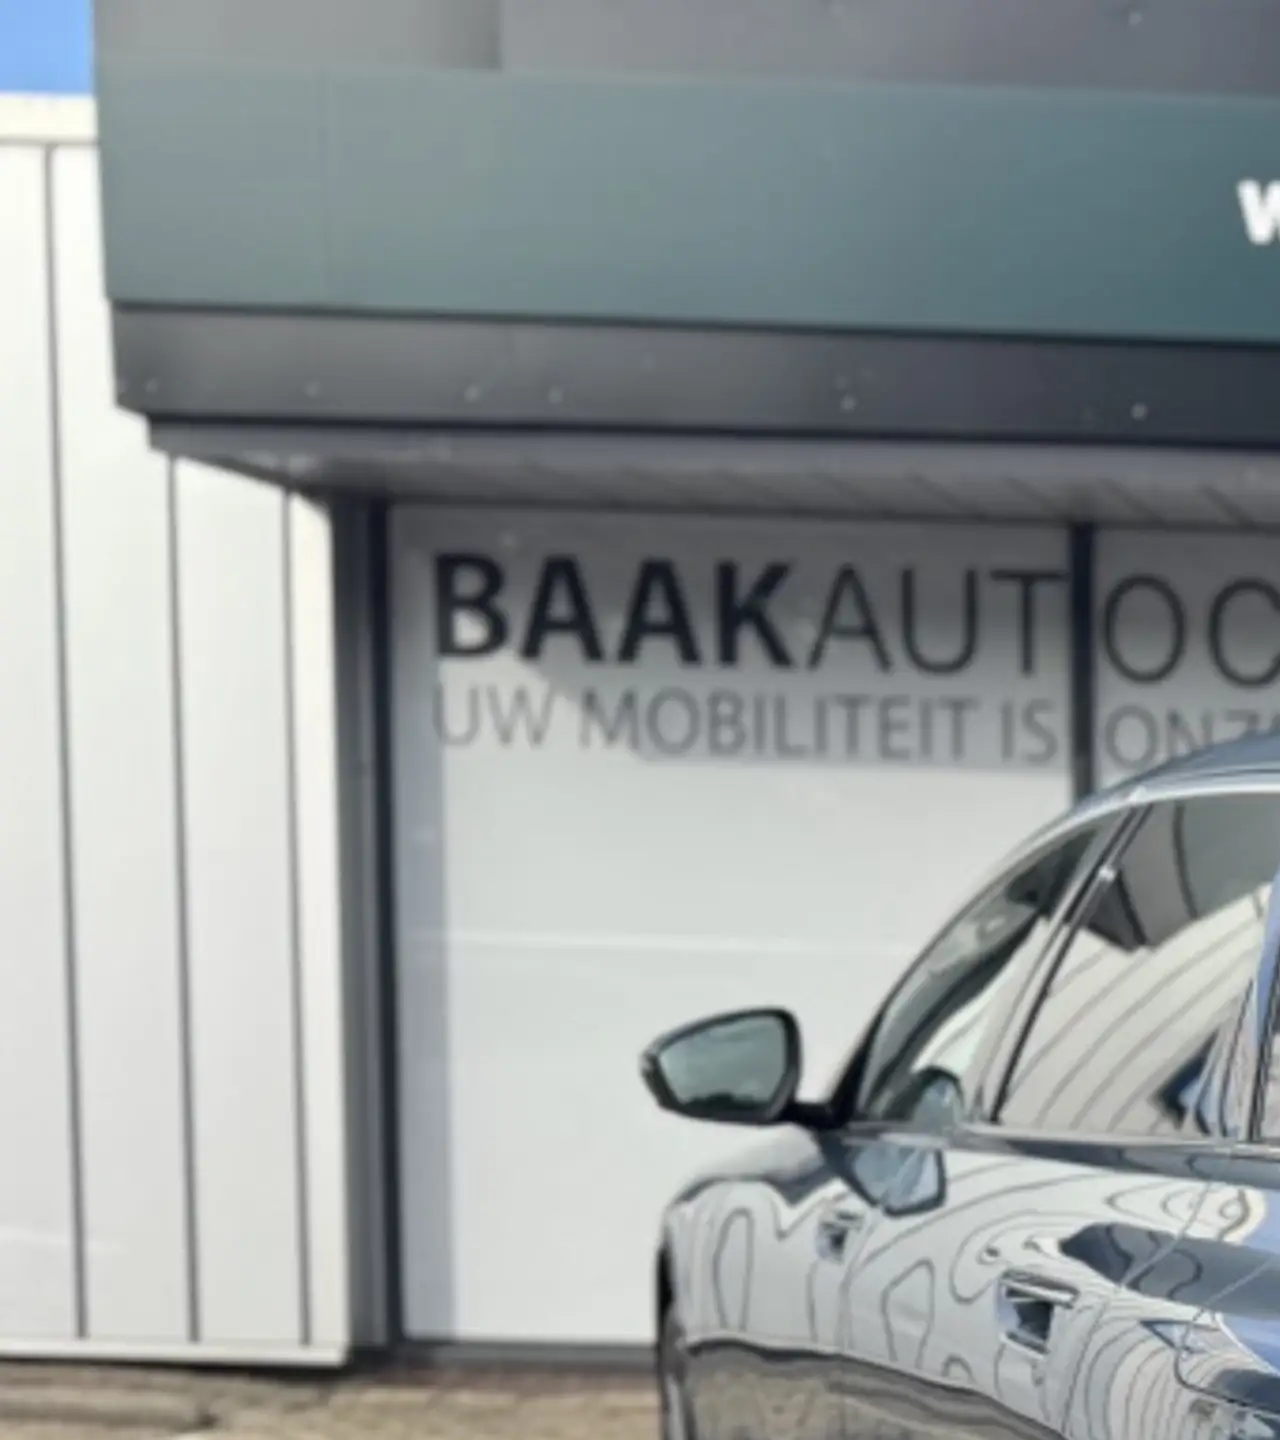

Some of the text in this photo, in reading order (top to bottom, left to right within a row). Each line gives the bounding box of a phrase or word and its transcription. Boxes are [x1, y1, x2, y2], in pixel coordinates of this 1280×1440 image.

[432, 681, 554, 750] UW
[580, 687, 979, 759] MOBILITEIT
[1000, 695, 1060, 761] IS
